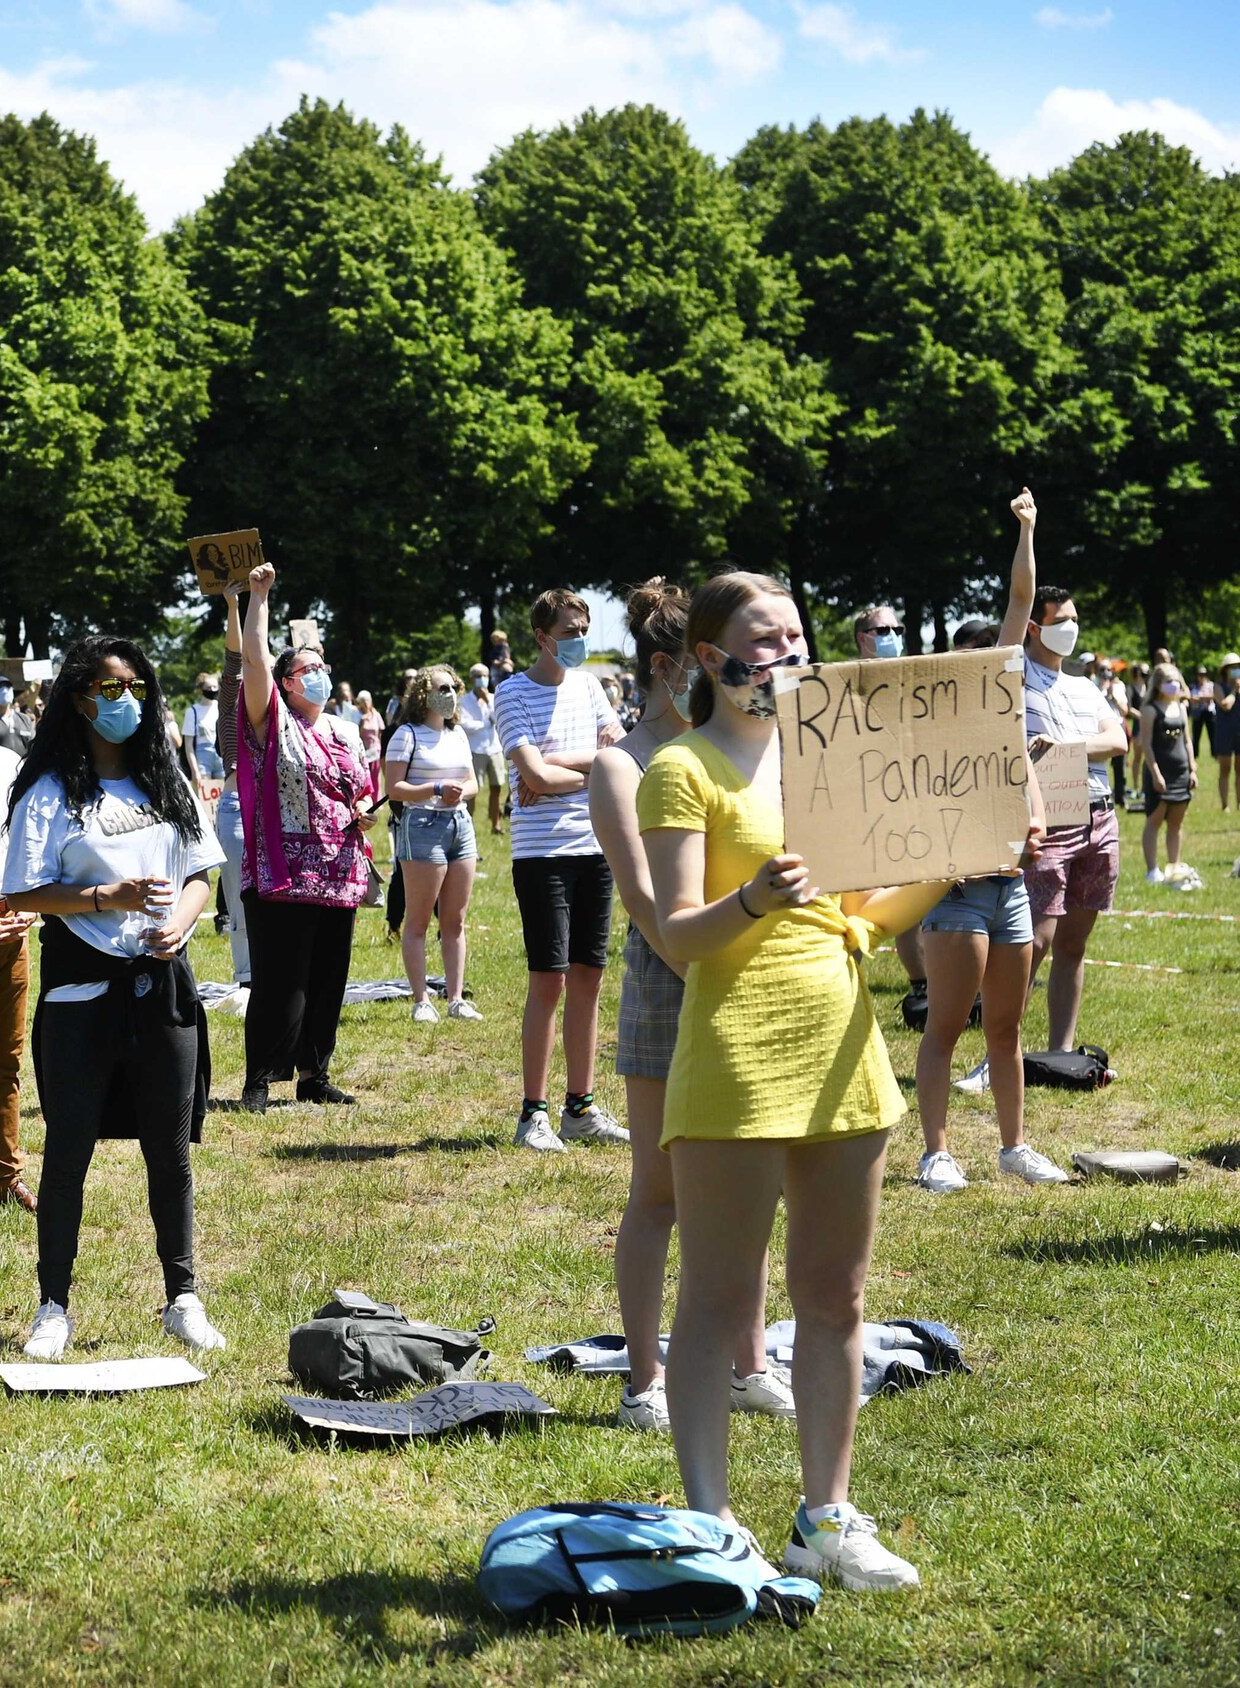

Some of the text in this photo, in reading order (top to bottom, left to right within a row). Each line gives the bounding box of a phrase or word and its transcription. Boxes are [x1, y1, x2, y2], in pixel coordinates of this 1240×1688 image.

[229, 542, 260, 569] BLM
[982, 666, 1014, 715] is
[810, 745, 1028, 813] A Pandemic
